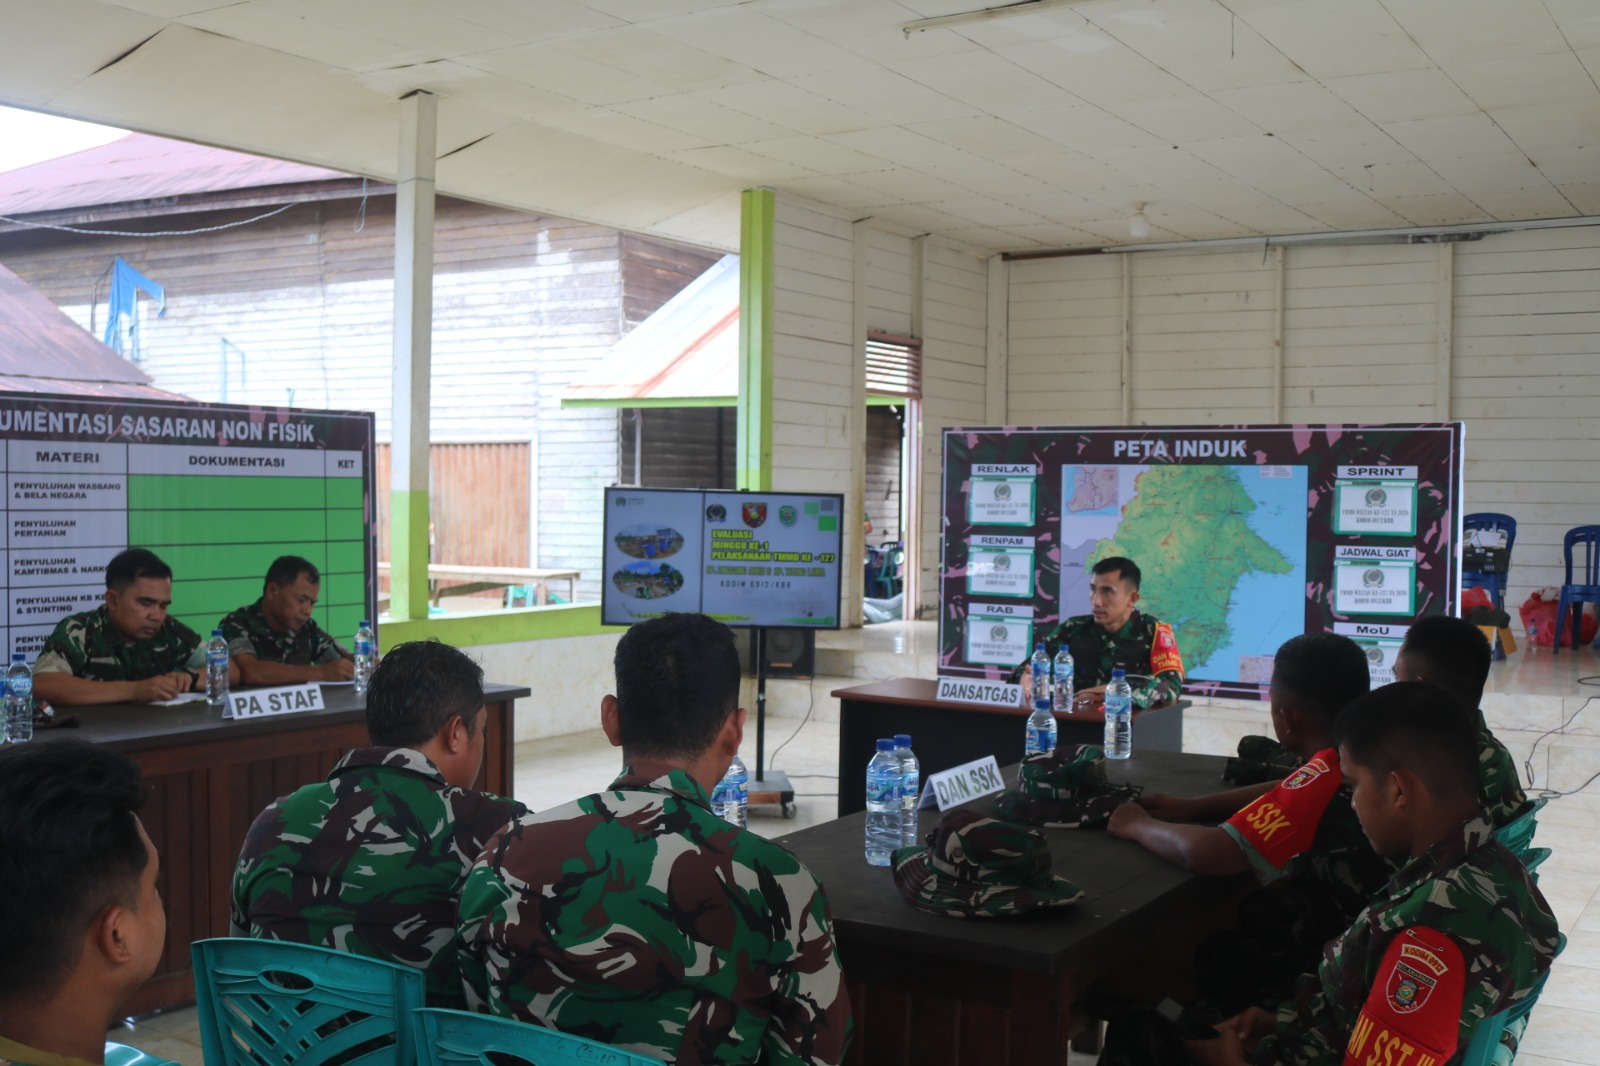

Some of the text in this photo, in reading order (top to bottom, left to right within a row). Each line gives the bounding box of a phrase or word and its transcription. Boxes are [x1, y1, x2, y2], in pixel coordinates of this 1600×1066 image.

[120, 415, 216, 439] SASARAN
[222, 420, 262, 440] NON
[268, 422, 315, 443] FISIK
[1114, 440, 1248, 457] PETA INDUK
[36, 451, 99, 464] MATERI
[188, 455, 285, 468] DOKUMENTASI
[338, 459, 355, 469] KET
[712, 529, 753, 539] EVALUASI
[712, 540, 747, 550] MINGGU
[711, 551, 772, 561] PELAKSANAAN
[1341, 548, 1410, 557] JADWAL GIAT
[14, 567, 69, 576] KAMTIBMAS
[16, 596, 78, 605] PENYULUHAN
[26, 605, 72, 613] STUNTING
[1356, 626, 1390, 634] MoU
[941, 682, 1018, 703] DANSATGAS
[234, 689, 317, 716] PA STAF
[936, 763, 1001, 805] DAN SSK
[1246, 802, 1291, 842] SSK
[1404, 946, 1445, 973] KODIM 0912
